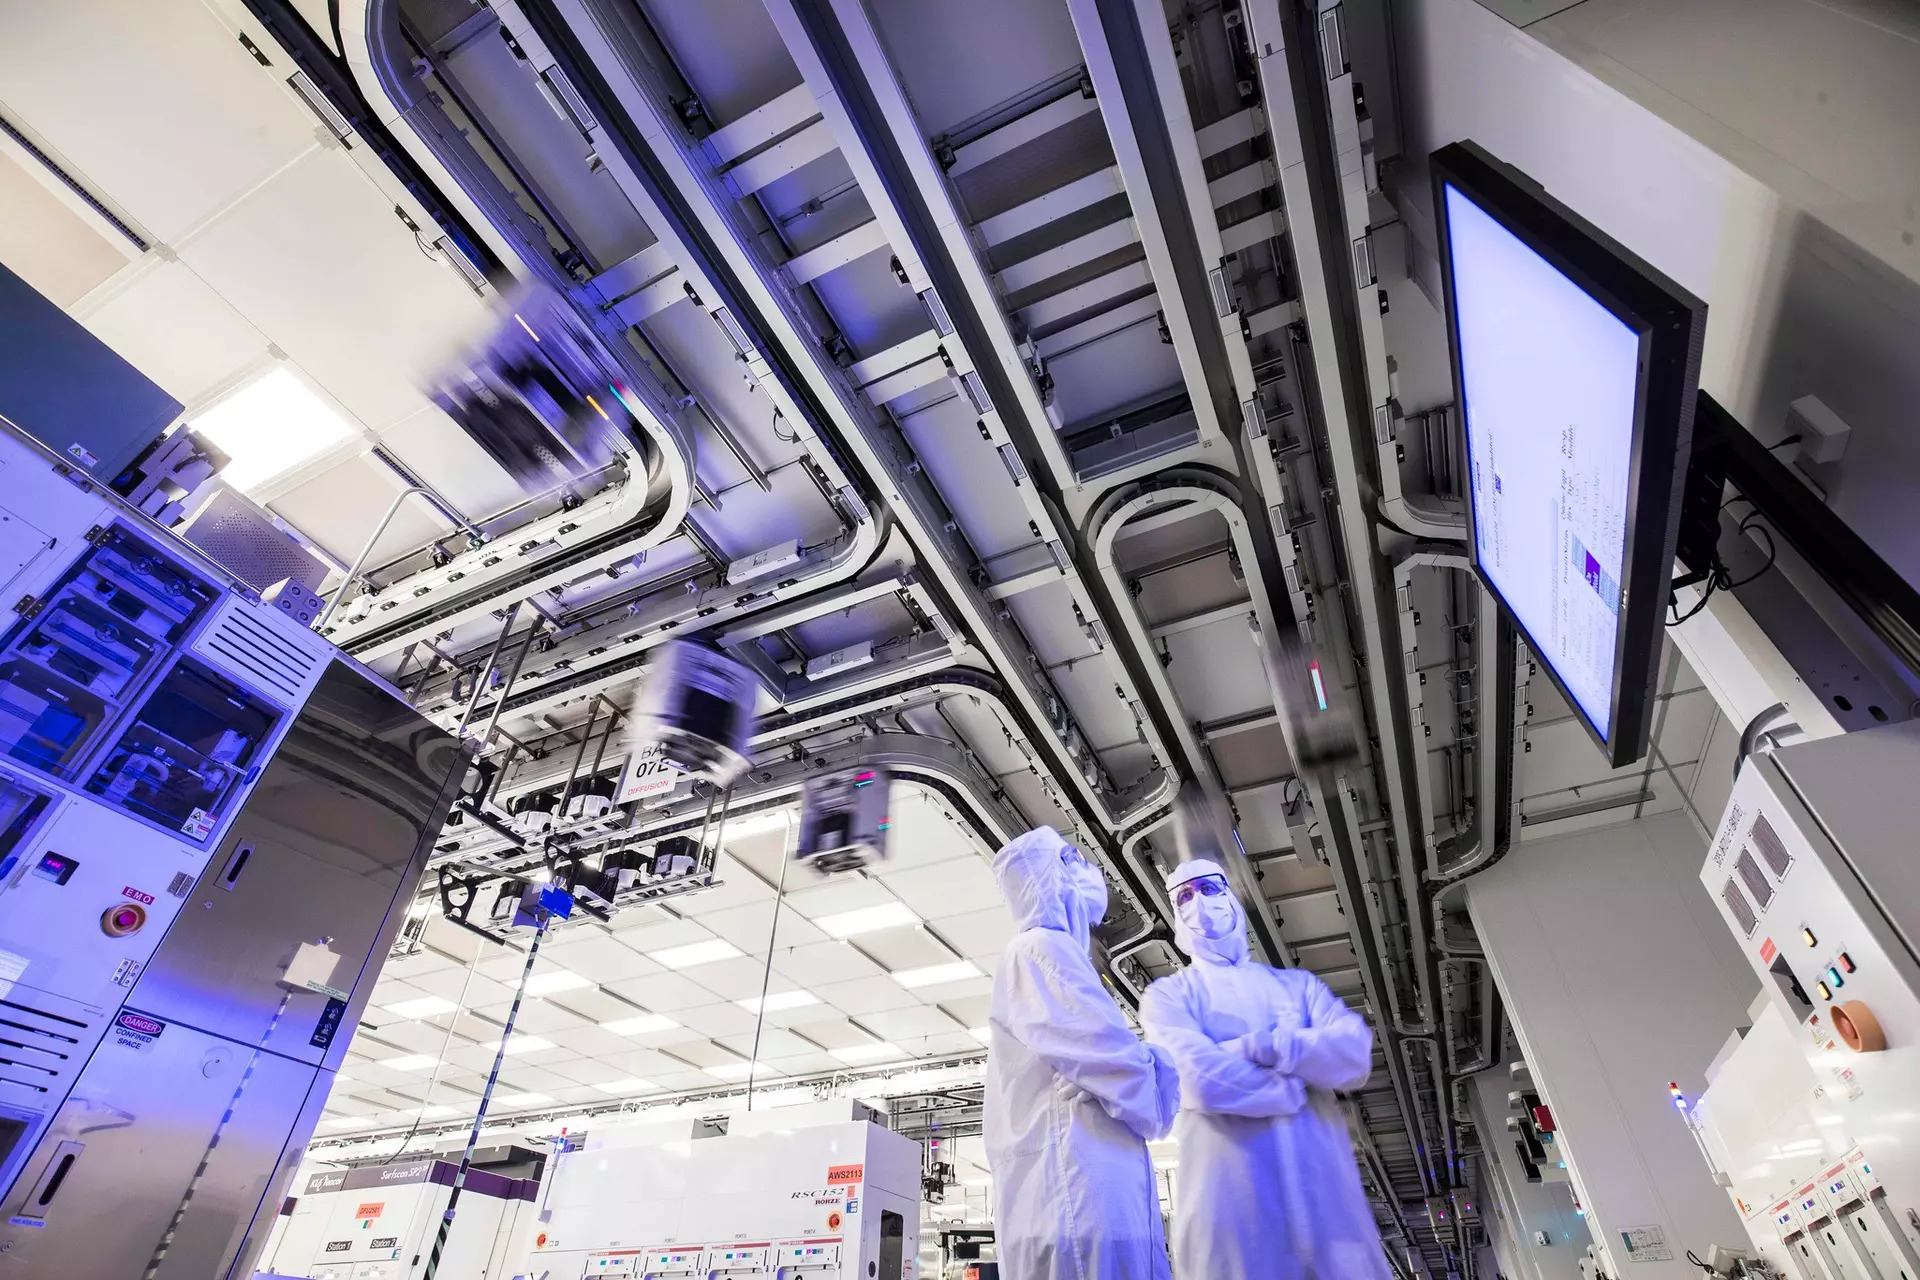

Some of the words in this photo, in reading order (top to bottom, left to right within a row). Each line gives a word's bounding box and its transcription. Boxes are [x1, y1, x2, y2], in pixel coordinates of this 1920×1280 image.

[641, 746, 663, 759] BA
[628, 780, 669, 796] DIFFUSION
[125, 889, 152, 904] EMO
[125, 1016, 159, 1034] DANGER
[116, 1028, 153, 1044] CONFINED
[117, 1037, 142, 1050] SPACE
[381, 1168, 408, 1180] Surfscan
[828, 1170, 863, 1180] AWS2113
[327, 1242, 346, 1252] Station
[372, 1240, 391, 1248] Station
